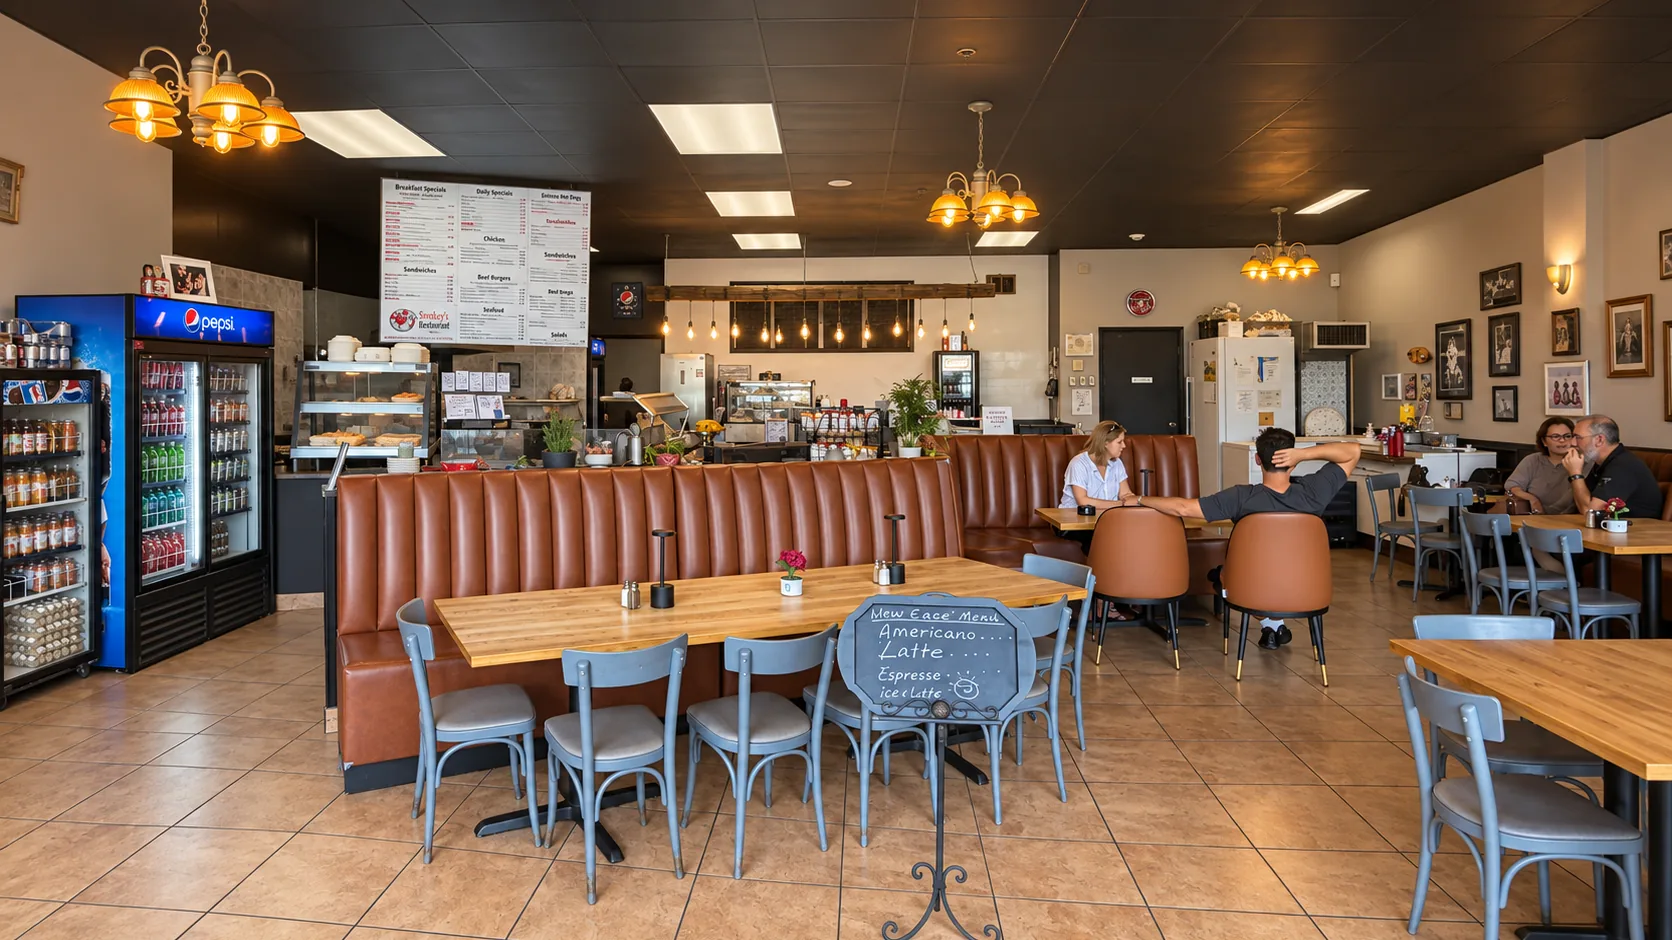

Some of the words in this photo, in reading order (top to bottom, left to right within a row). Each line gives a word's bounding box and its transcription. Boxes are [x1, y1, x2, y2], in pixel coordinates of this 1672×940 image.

[476, 188, 490, 196] Daily
[491, 189, 513, 197] Specials
[483, 235, 505, 243] Chicken
[201, 316, 235, 332] pepsi
[879, 623, 976, 640] Americano
[878, 640, 943, 661] Latte
